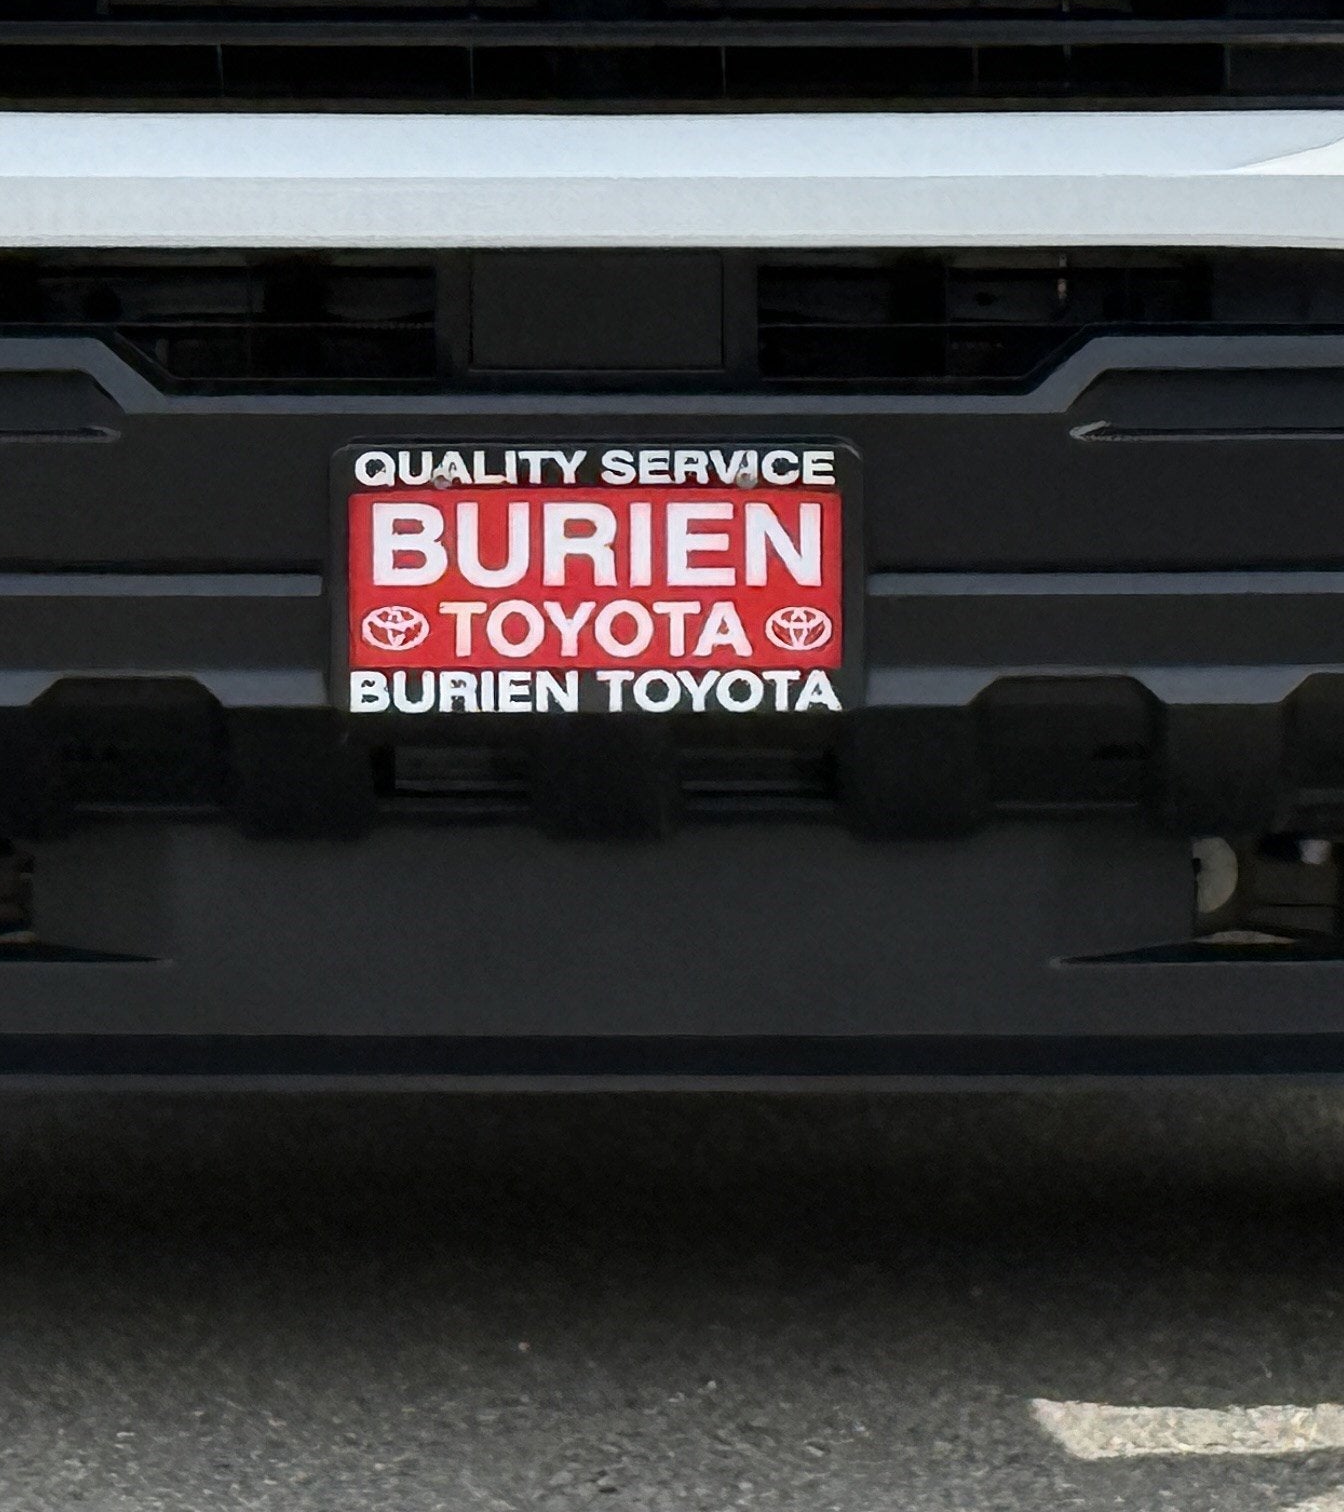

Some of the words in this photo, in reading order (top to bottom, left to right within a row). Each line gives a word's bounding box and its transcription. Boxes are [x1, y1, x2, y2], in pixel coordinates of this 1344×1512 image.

[355, 450, 586, 487] QUALITY
[601, 450, 836, 486] SERVICE
[372, 501, 822, 588] BURIEN
[439, 599, 754, 658] TOYOTA
[349, 670, 580, 713] BURIEN
[596, 670, 843, 713] TOYOTA
